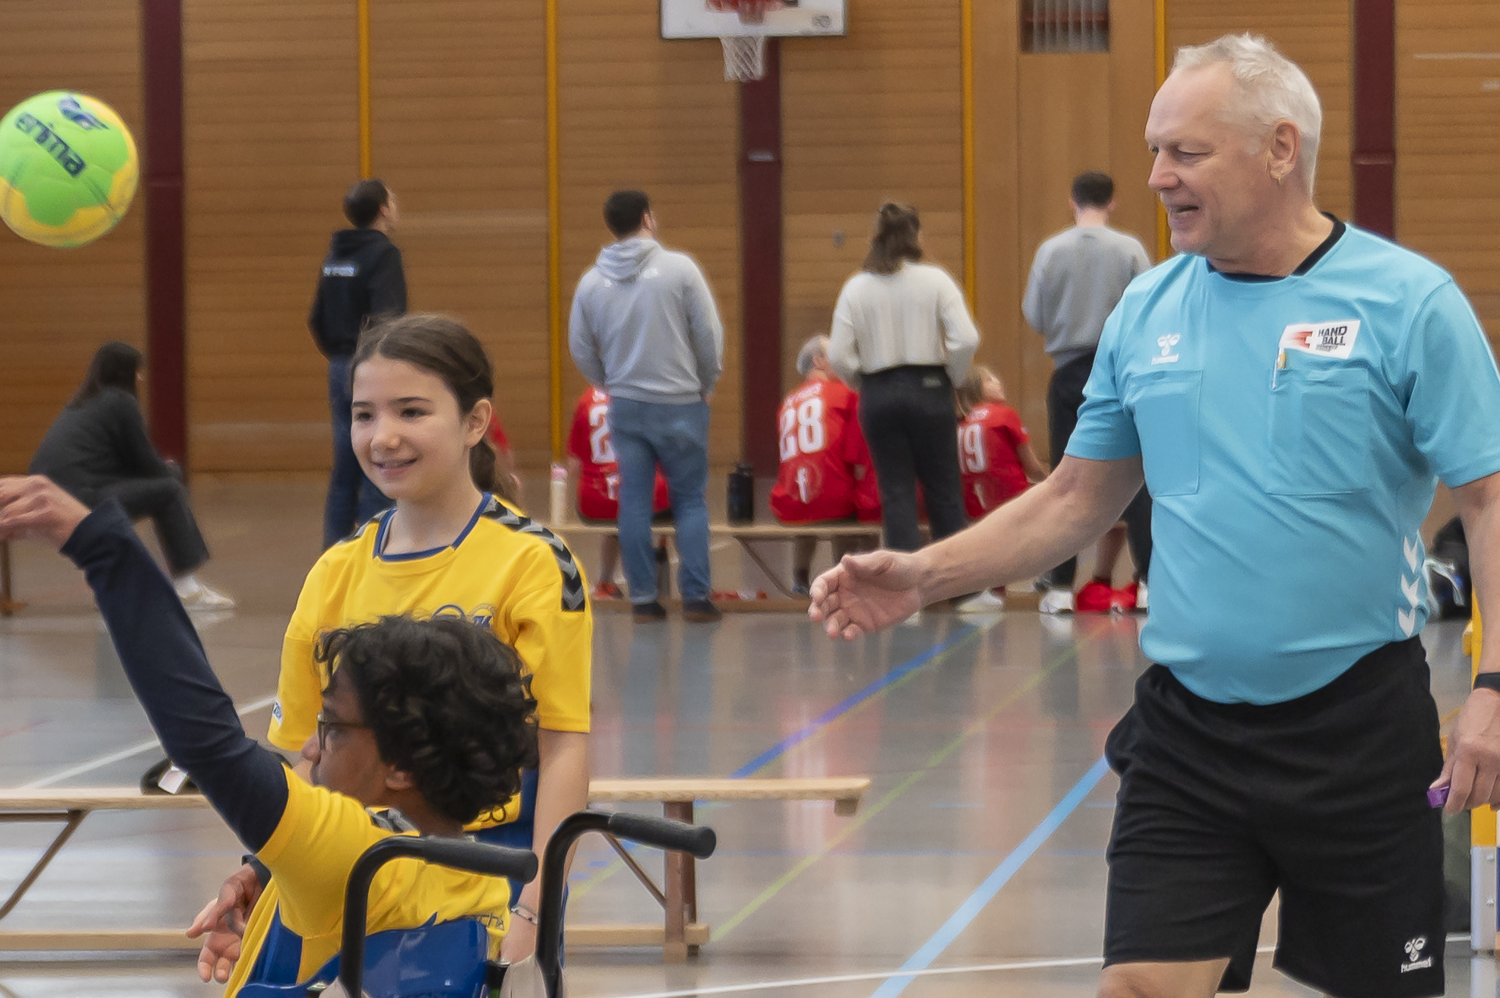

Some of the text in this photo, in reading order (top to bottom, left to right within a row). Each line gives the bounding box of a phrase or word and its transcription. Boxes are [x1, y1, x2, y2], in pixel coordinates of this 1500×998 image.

[15, 113, 86, 178] erima
[1318, 326, 1347, 337] HAND
[1322, 336, 1345, 346] BALL
[780, 398, 824, 462] 28
